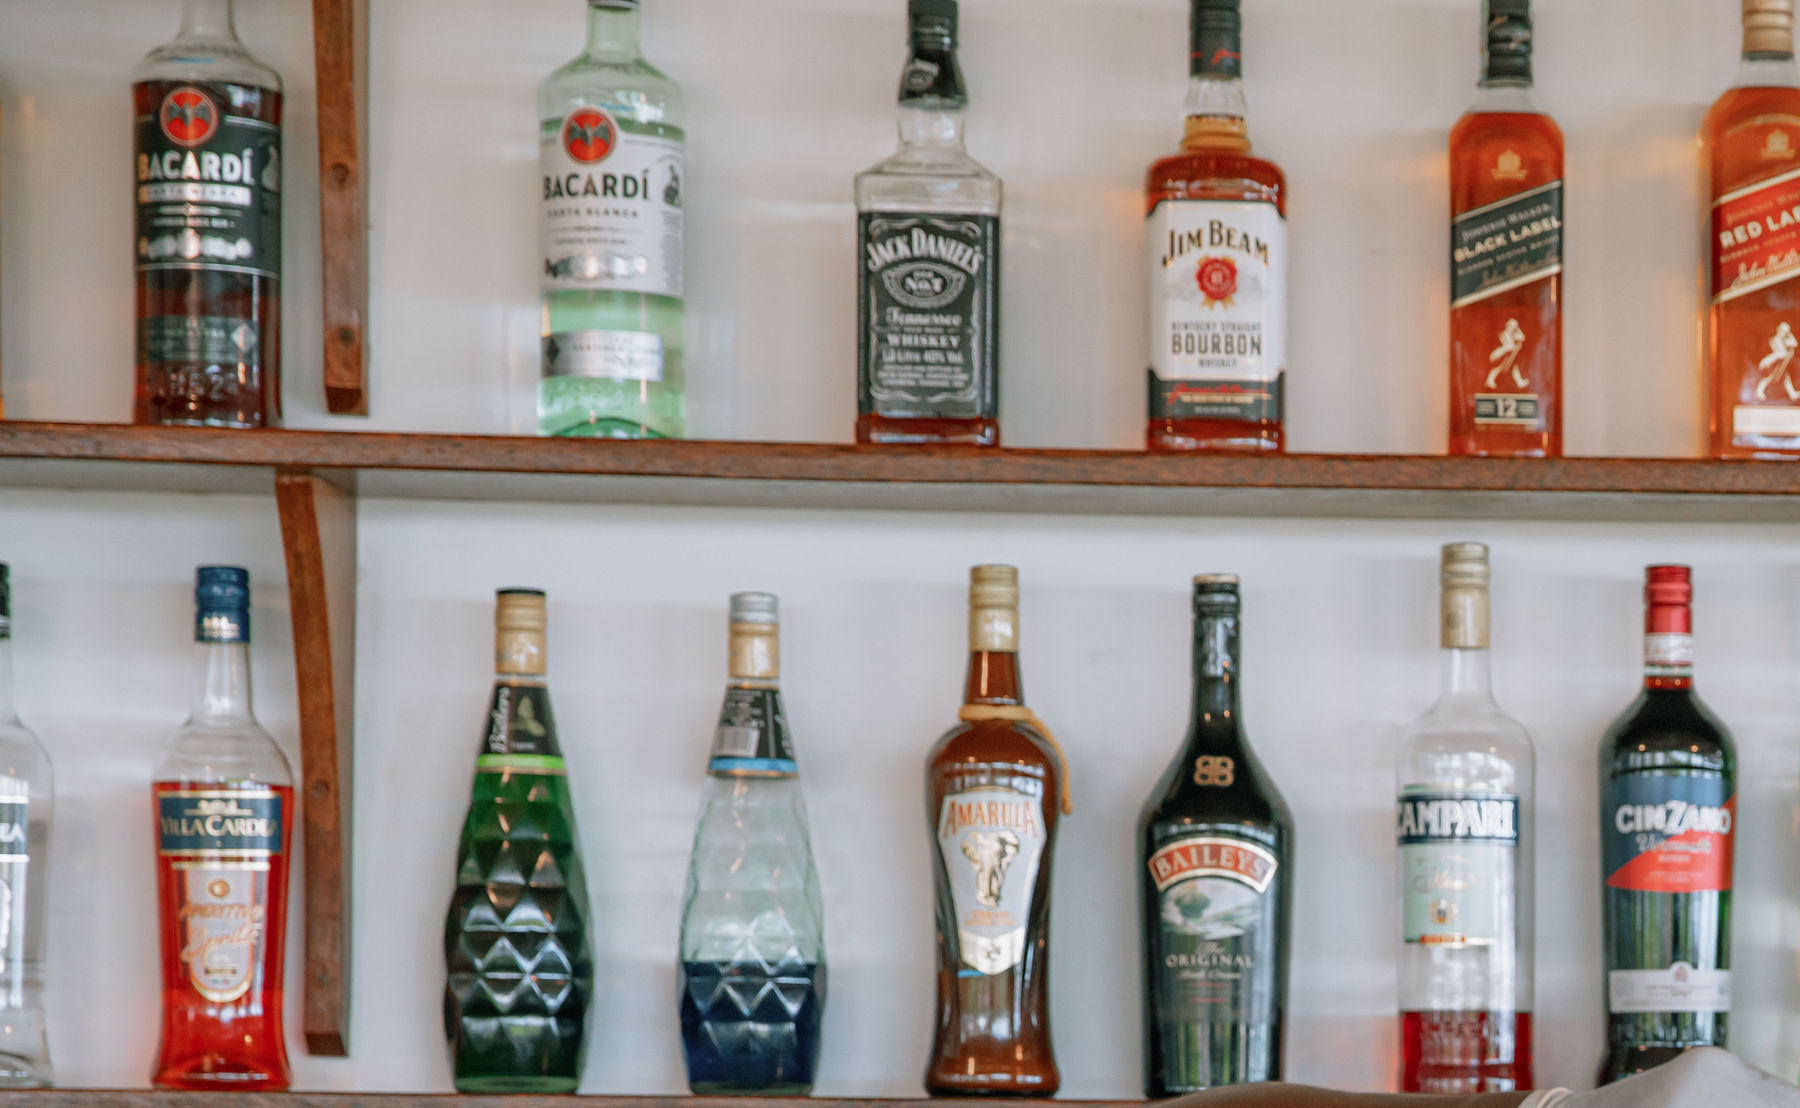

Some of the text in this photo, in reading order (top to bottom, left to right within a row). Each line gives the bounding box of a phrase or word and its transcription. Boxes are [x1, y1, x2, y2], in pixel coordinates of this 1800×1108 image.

[138, 147, 255, 185] BACARDÍ
[543, 168, 651, 201] BACARDÍ
[866, 227, 984, 276] JACK DANIEL'S
[1162, 219, 1270, 267] JIM BEAM
[1454, 216, 1562, 263] BLACK LABEL
[1719, 221, 1763, 249] RED
[887, 334, 960, 348] WHISKEY
[1172, 333, 1262, 356] BOURBON
[1496, 398, 1518, 418] 12
[943, 800, 1039, 840] AMARULA
[1615, 800, 1732, 835] CINZANO
[1155, 844, 1265, 879] BAILEYS
[1165, 954, 1255, 968] ORIGINAL
